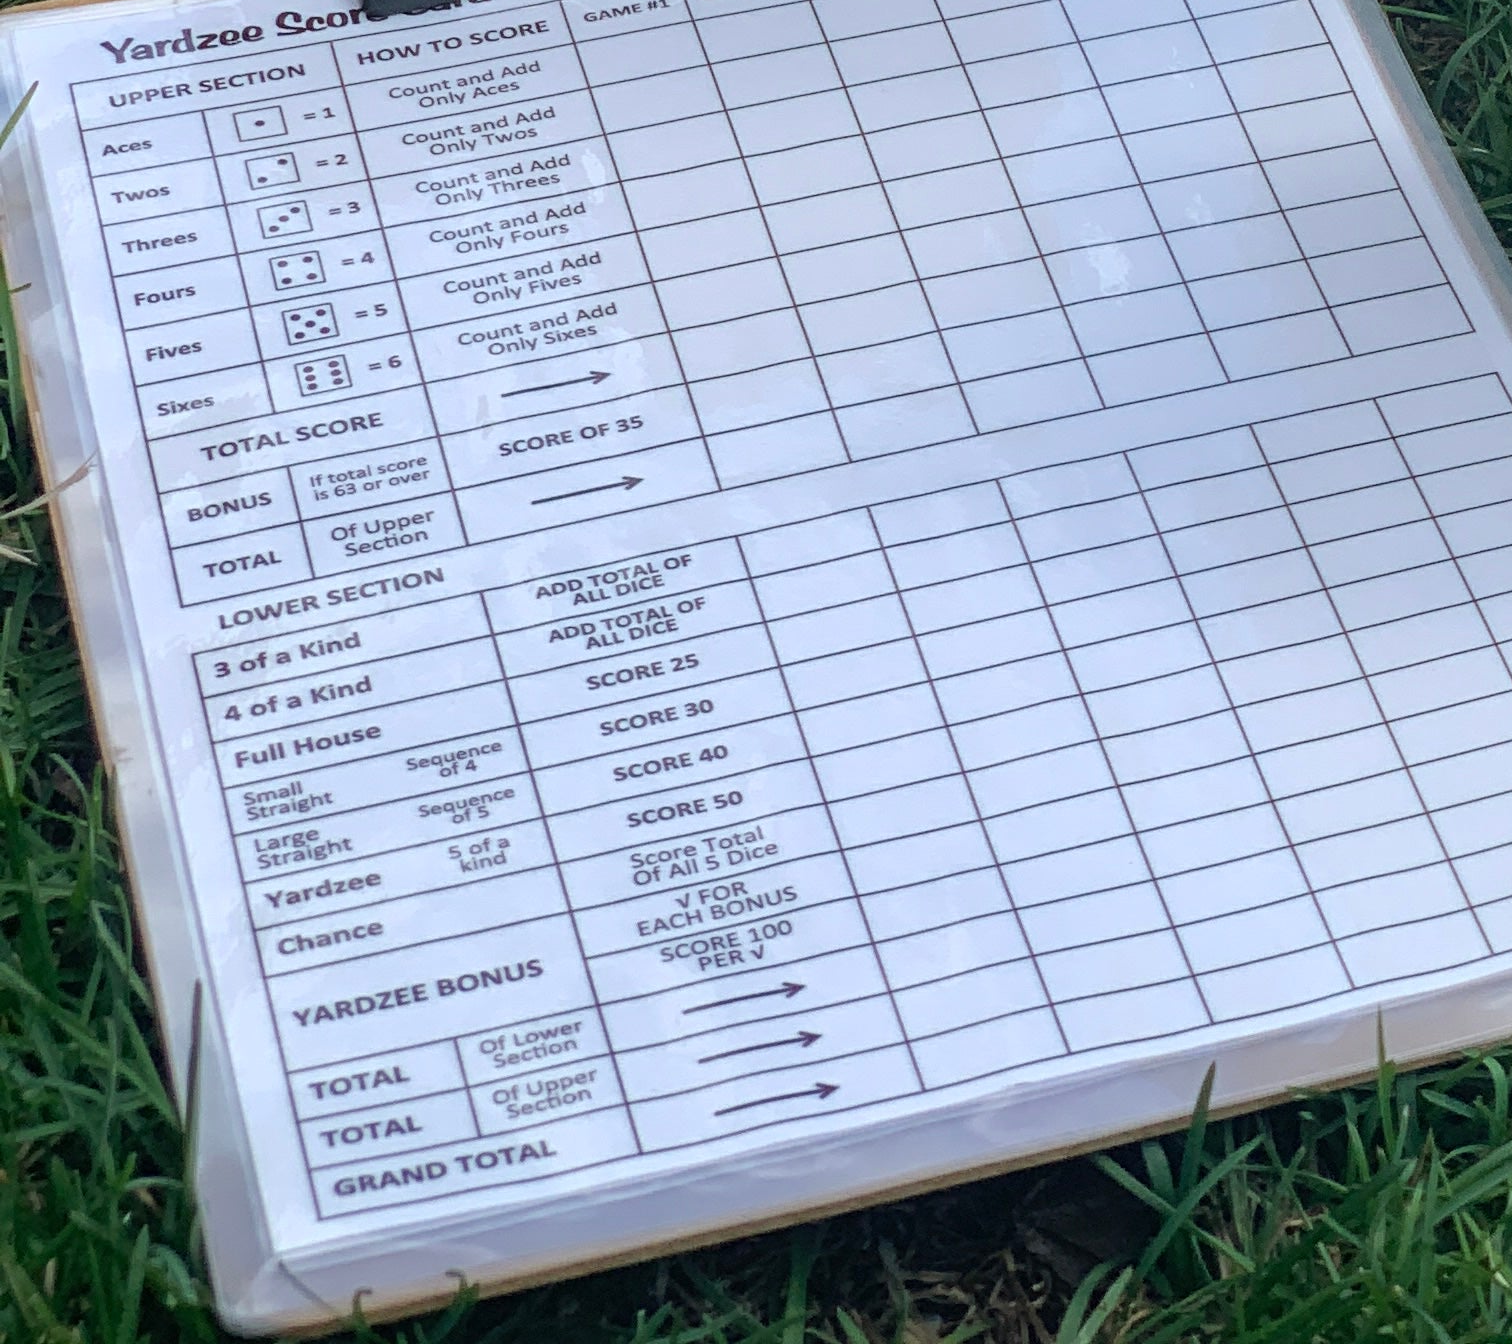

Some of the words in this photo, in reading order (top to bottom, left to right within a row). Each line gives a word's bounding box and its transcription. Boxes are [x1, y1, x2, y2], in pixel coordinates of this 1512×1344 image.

[584, 3, 642, 22] GAME
[99, 26, 265, 64] Yardzee
[356, 44, 421, 65] HOW
[426, 37, 462, 52] TO
[469, 20, 550, 46] SCORE
[108, 84, 193, 108] UPPER
[198, 64, 306, 93] SECTION
[389, 80, 452, 98] Count
[456, 69, 495, 87] and
[501, 60, 541, 78] Add
[418, 92, 466, 108] Only
[472, 82, 520, 99] Aces
[322, 107, 336, 119] 1
[402, 126, 466, 145] Count
[470, 115, 509, 133] and
[516, 106, 556, 125] Add
[102, 140, 152, 157] Aces
[429, 138, 476, 156] Only
[481, 128, 538, 145] Twos
[334, 154, 348, 166] 2
[415, 173, 479, 193] Count
[484, 162, 524, 180] and
[530, 154, 571, 172] Add
[110, 186, 170, 204] Twos
[435, 188, 483, 205] Only
[487, 174, 560, 194] Threes
[346, 201, 361, 214] 3
[429, 222, 494, 242] Count
[499, 211, 538, 230] and
[545, 201, 586, 221] Add
[121, 232, 198, 254] Threes
[456, 236, 504, 254] Only
[510, 224, 570, 244] Fours
[361, 252, 375, 264] 4
[443, 272, 508, 294] Count
[514, 261, 554, 280] and
[560, 251, 602, 271] Add
[134, 286, 196, 306] Fours
[473, 286, 522, 304] Only
[528, 275, 582, 294] Fives
[374, 304, 388, 317] 5
[458, 324, 524, 345] Count
[529, 312, 569, 331] and
[576, 302, 618, 322] Add
[146, 342, 202, 362] Fives
[488, 337, 538, 355] Only
[543, 326, 598, 344] Sixes
[388, 355, 402, 368] 6
[156, 397, 215, 416] Sixes
[200, 431, 290, 461] TOTAL
[294, 412, 384, 442] SCORE
[498, 430, 574, 457] SCORE
[579, 423, 610, 440] OF
[616, 415, 644, 432] 35
[310, 474, 323, 487] If
[327, 465, 372, 484] total
[377, 457, 428, 474] score
[314, 490, 329, 501] is
[333, 483, 357, 497] 63
[362, 480, 382, 491] or
[388, 470, 430, 486] over
[186, 492, 272, 522] BONUS
[330, 523, 358, 541] Of
[363, 510, 434, 535] Upper
[344, 531, 428, 557] Section
[202, 551, 282, 578] TOTAL
[536, 579, 584, 599] ADD
[586, 562, 660, 587] TOTAL
[663, 554, 692, 570] OF
[218, 596, 320, 630] LOWER
[326, 568, 444, 606] SECTION
[573, 588, 612, 606] ALL
[614, 574, 665, 597] DICE
[549, 623, 596, 643] ADD
[599, 606, 674, 631] TOTAL
[676, 596, 706, 614] OF
[586, 632, 625, 650] ALL
[628, 618, 679, 640] DICE
[214, 662, 232, 678] 3
[238, 651, 268, 672] of
[275, 652, 292, 665] a
[298, 632, 362, 660] Kind
[586, 661, 666, 690] SCORE
[670, 653, 700, 672] 25
[224, 705, 242, 721] 4
[250, 695, 278, 717] of
[286, 696, 302, 709] a
[310, 675, 372, 704] Kind
[600, 706, 680, 736] SCORE
[684, 699, 714, 717] 30
[234, 742, 286, 768] Full
[292, 726, 381, 756] House
[406, 742, 502, 771] Sequence
[439, 763, 463, 777] of
[465, 759, 478, 772] 4
[613, 752, 694, 782] SCORE
[699, 745, 728, 762] 40
[243, 781, 303, 806] Small
[246, 792, 334, 821] Straight
[417, 789, 515, 818] Sequence
[452, 809, 475, 825] of
[477, 805, 490, 820] 5
[626, 798, 708, 828] SCORE
[712, 791, 744, 810] 50
[253, 827, 320, 856] Large
[257, 837, 354, 870] Straight
[448, 845, 462, 860] 5
[469, 838, 491, 855] of
[497, 838, 510, 849] a
[630, 846, 698, 869] Score
[701, 825, 764, 852] Total
[459, 850, 507, 873] kind
[632, 865, 661, 886] Of
[669, 858, 699, 879] All
[705, 855, 720, 871] 5
[726, 844, 778, 866] Dice
[264, 874, 381, 908] Yardzee
[698, 881, 748, 905] FOR
[636, 909, 704, 937] EACH
[709, 886, 798, 920] BONUS
[276, 922, 384, 956] Chance
[660, 932, 742, 962] SCORE
[747, 920, 792, 943] 100
[698, 950, 746, 971] PER
[292, 983, 429, 1027] YARDZEE
[435, 959, 544, 997] BONUS
[479, 1035, 506, 1054] Of
[512, 1022, 582, 1046] Lower
[493, 1040, 578, 1068] Section
[308, 1066, 411, 1100] TOTAL
[492, 1085, 520, 1105] Of
[526, 1070, 597, 1096] Upper
[506, 1080, 592, 1119] Section
[319, 1116, 423, 1148] TOTAL
[332, 1162, 448, 1197] GRAND
[453, 1140, 557, 1173] TOTAL
